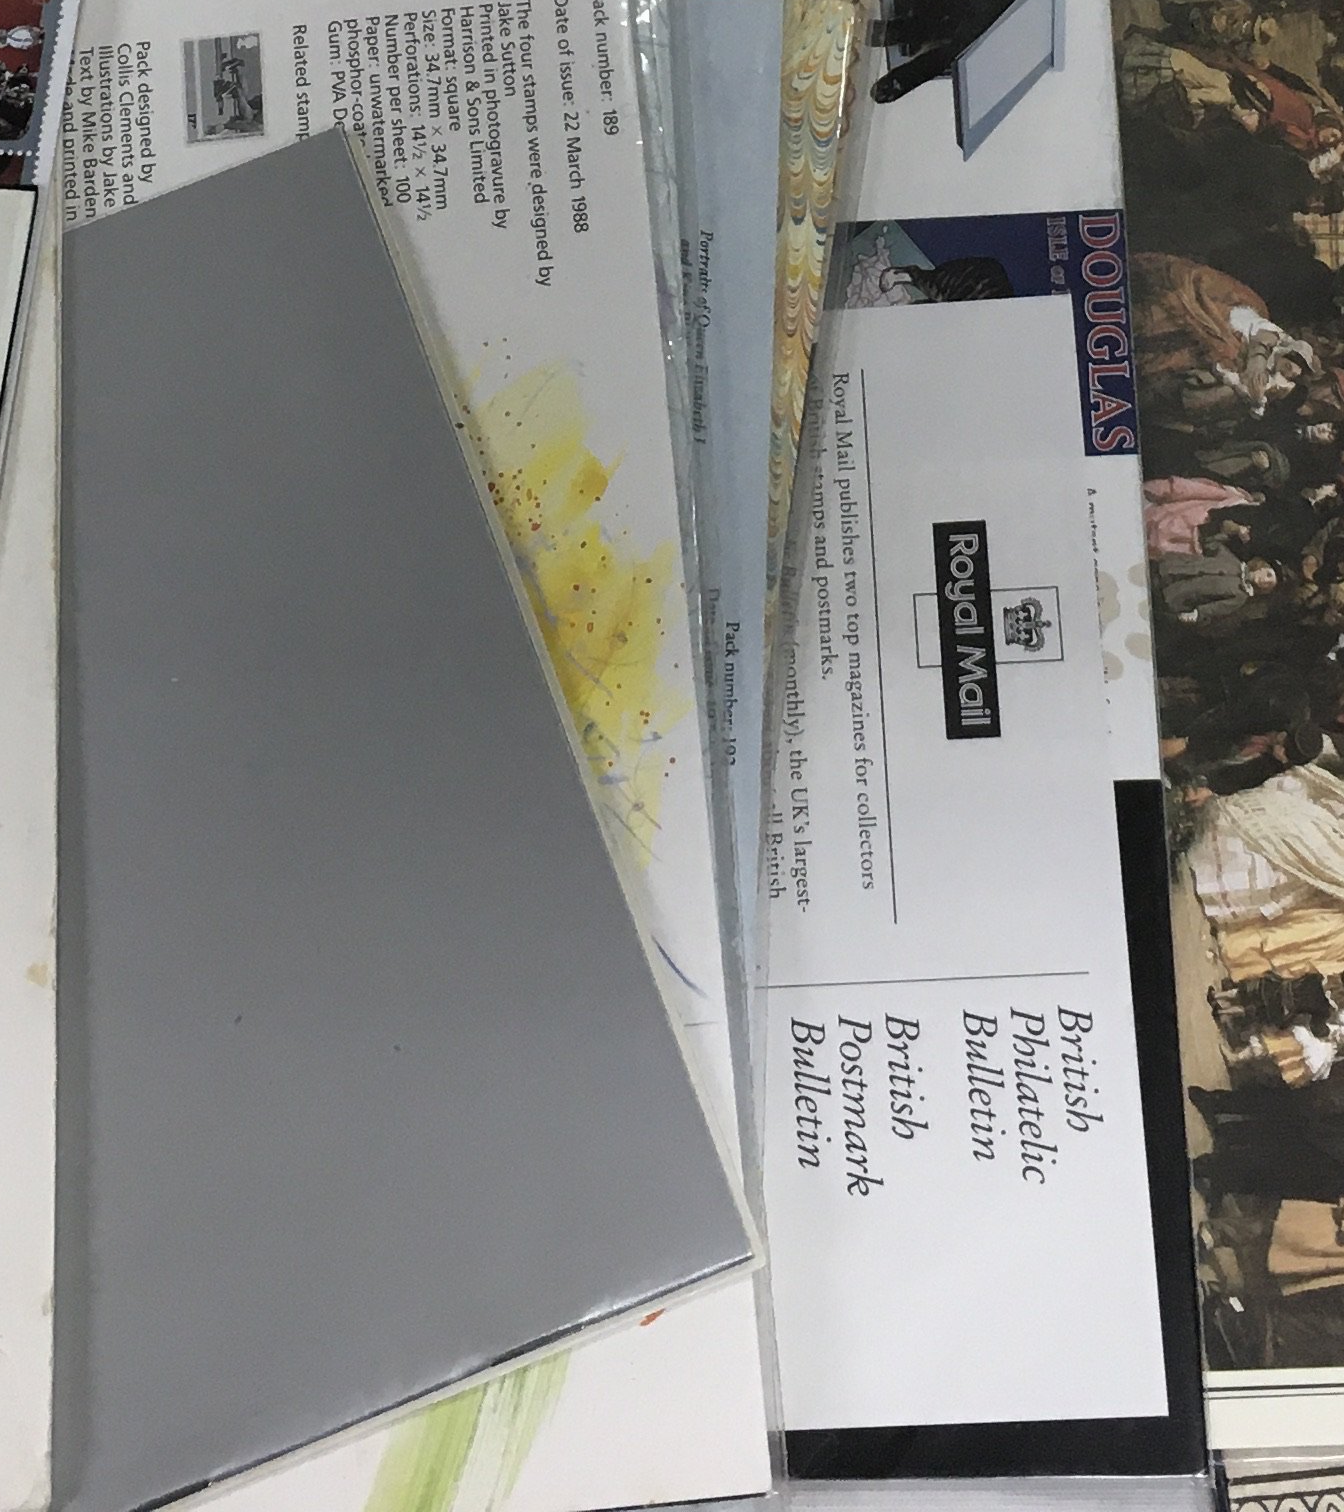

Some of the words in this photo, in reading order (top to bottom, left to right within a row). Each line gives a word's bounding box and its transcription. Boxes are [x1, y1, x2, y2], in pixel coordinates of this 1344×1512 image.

[557, 36, 573, 52] of
[558, 56, 575, 106] issue:
[595, 32, 614, 104] number:
[562, 111, 580, 131] 22
[563, 136, 585, 190] March
[601, 109, 620, 136] 189
[570, 195, 589, 233] 1988
[1078, 213, 1135, 452] DOUGLAS
[945, 533, 985, 636] Royal
[956, 645, 991, 725] Mail
[791, 1016, 832, 1169] Bulletin
[838, 1014, 884, 1197] Postmark
[885, 1012, 929, 1140] British
[962, 1009, 1007, 1162] Bulletin
[1010, 1006, 1059, 1184] Philatelic
[1057, 1004, 1104, 1132] British
